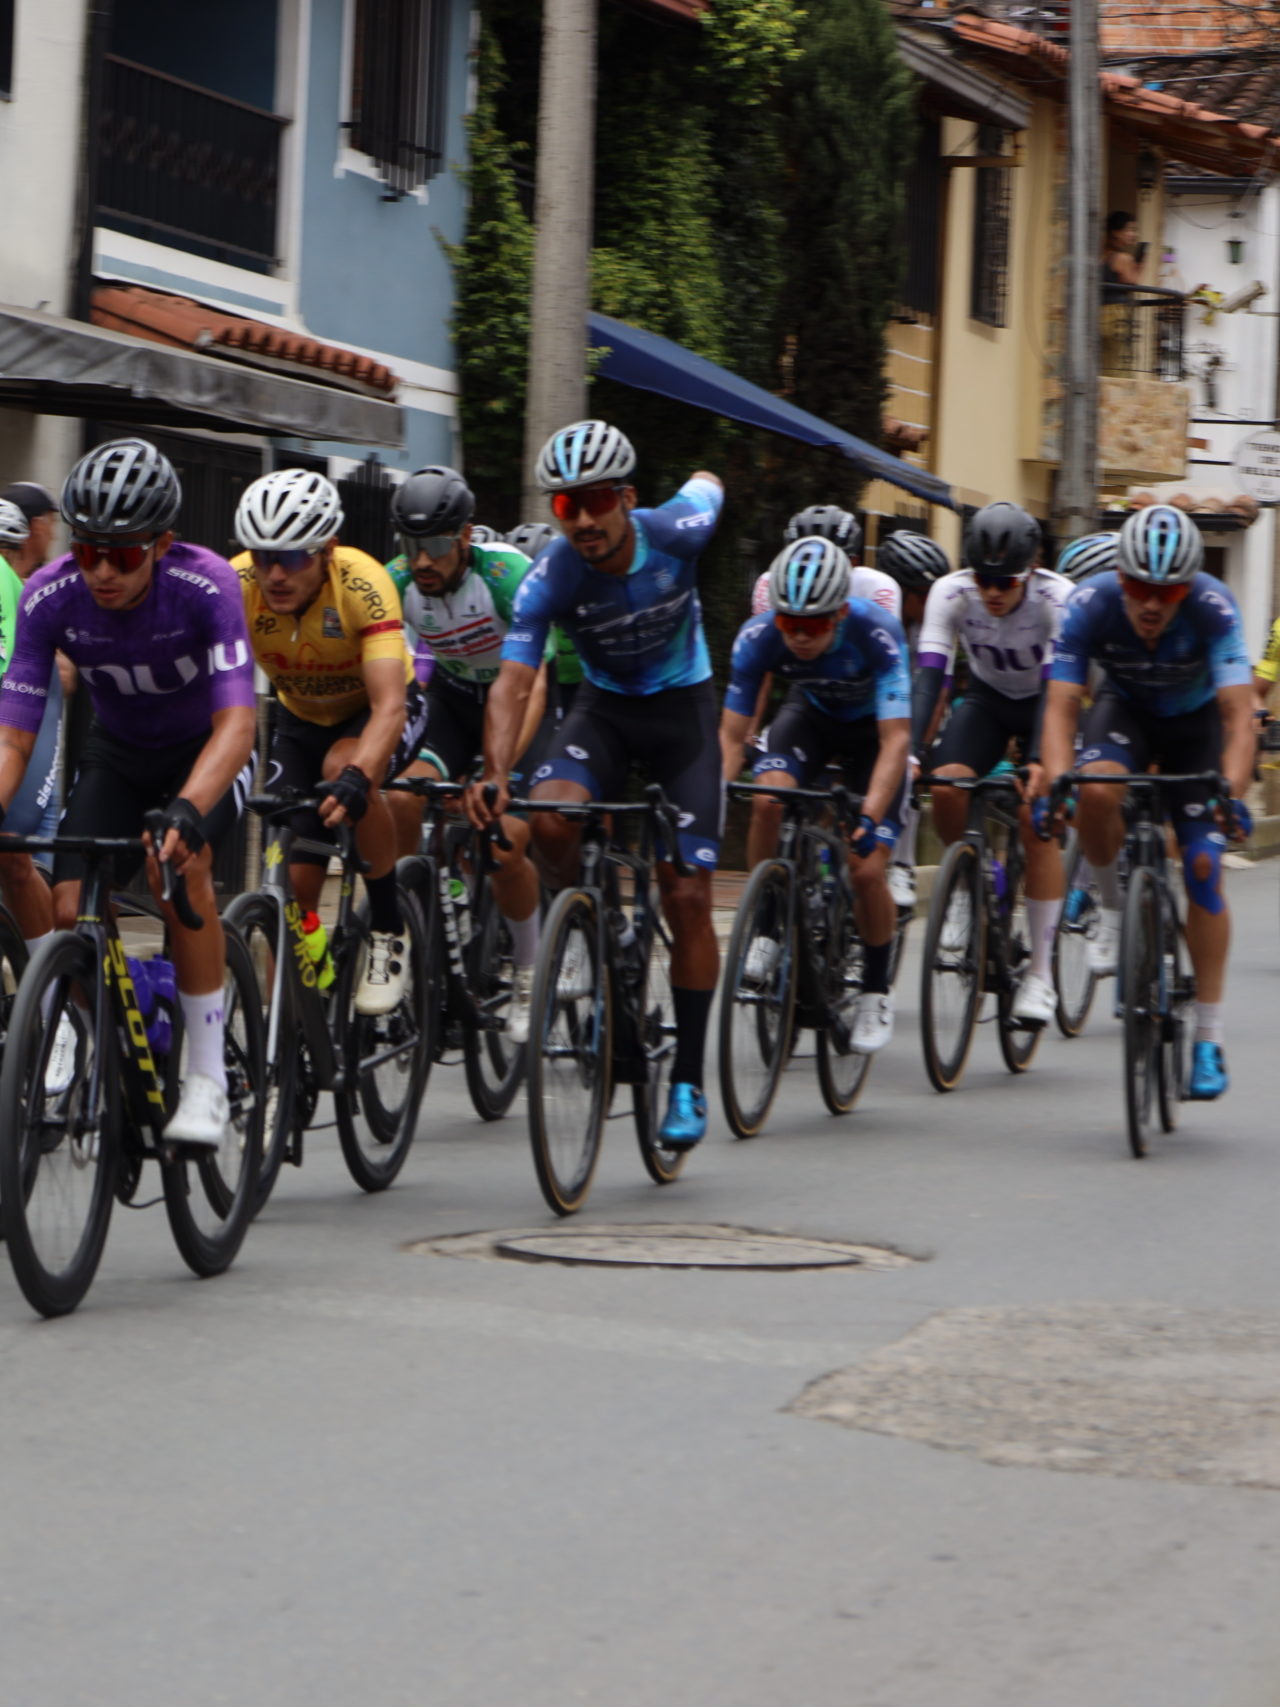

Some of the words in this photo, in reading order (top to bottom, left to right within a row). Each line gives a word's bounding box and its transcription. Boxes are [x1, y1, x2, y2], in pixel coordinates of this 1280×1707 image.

[24, 571, 81, 616] SCOTT
[167, 567, 221, 596] SCOTT
[106, 937, 167, 1114] SCOTT
